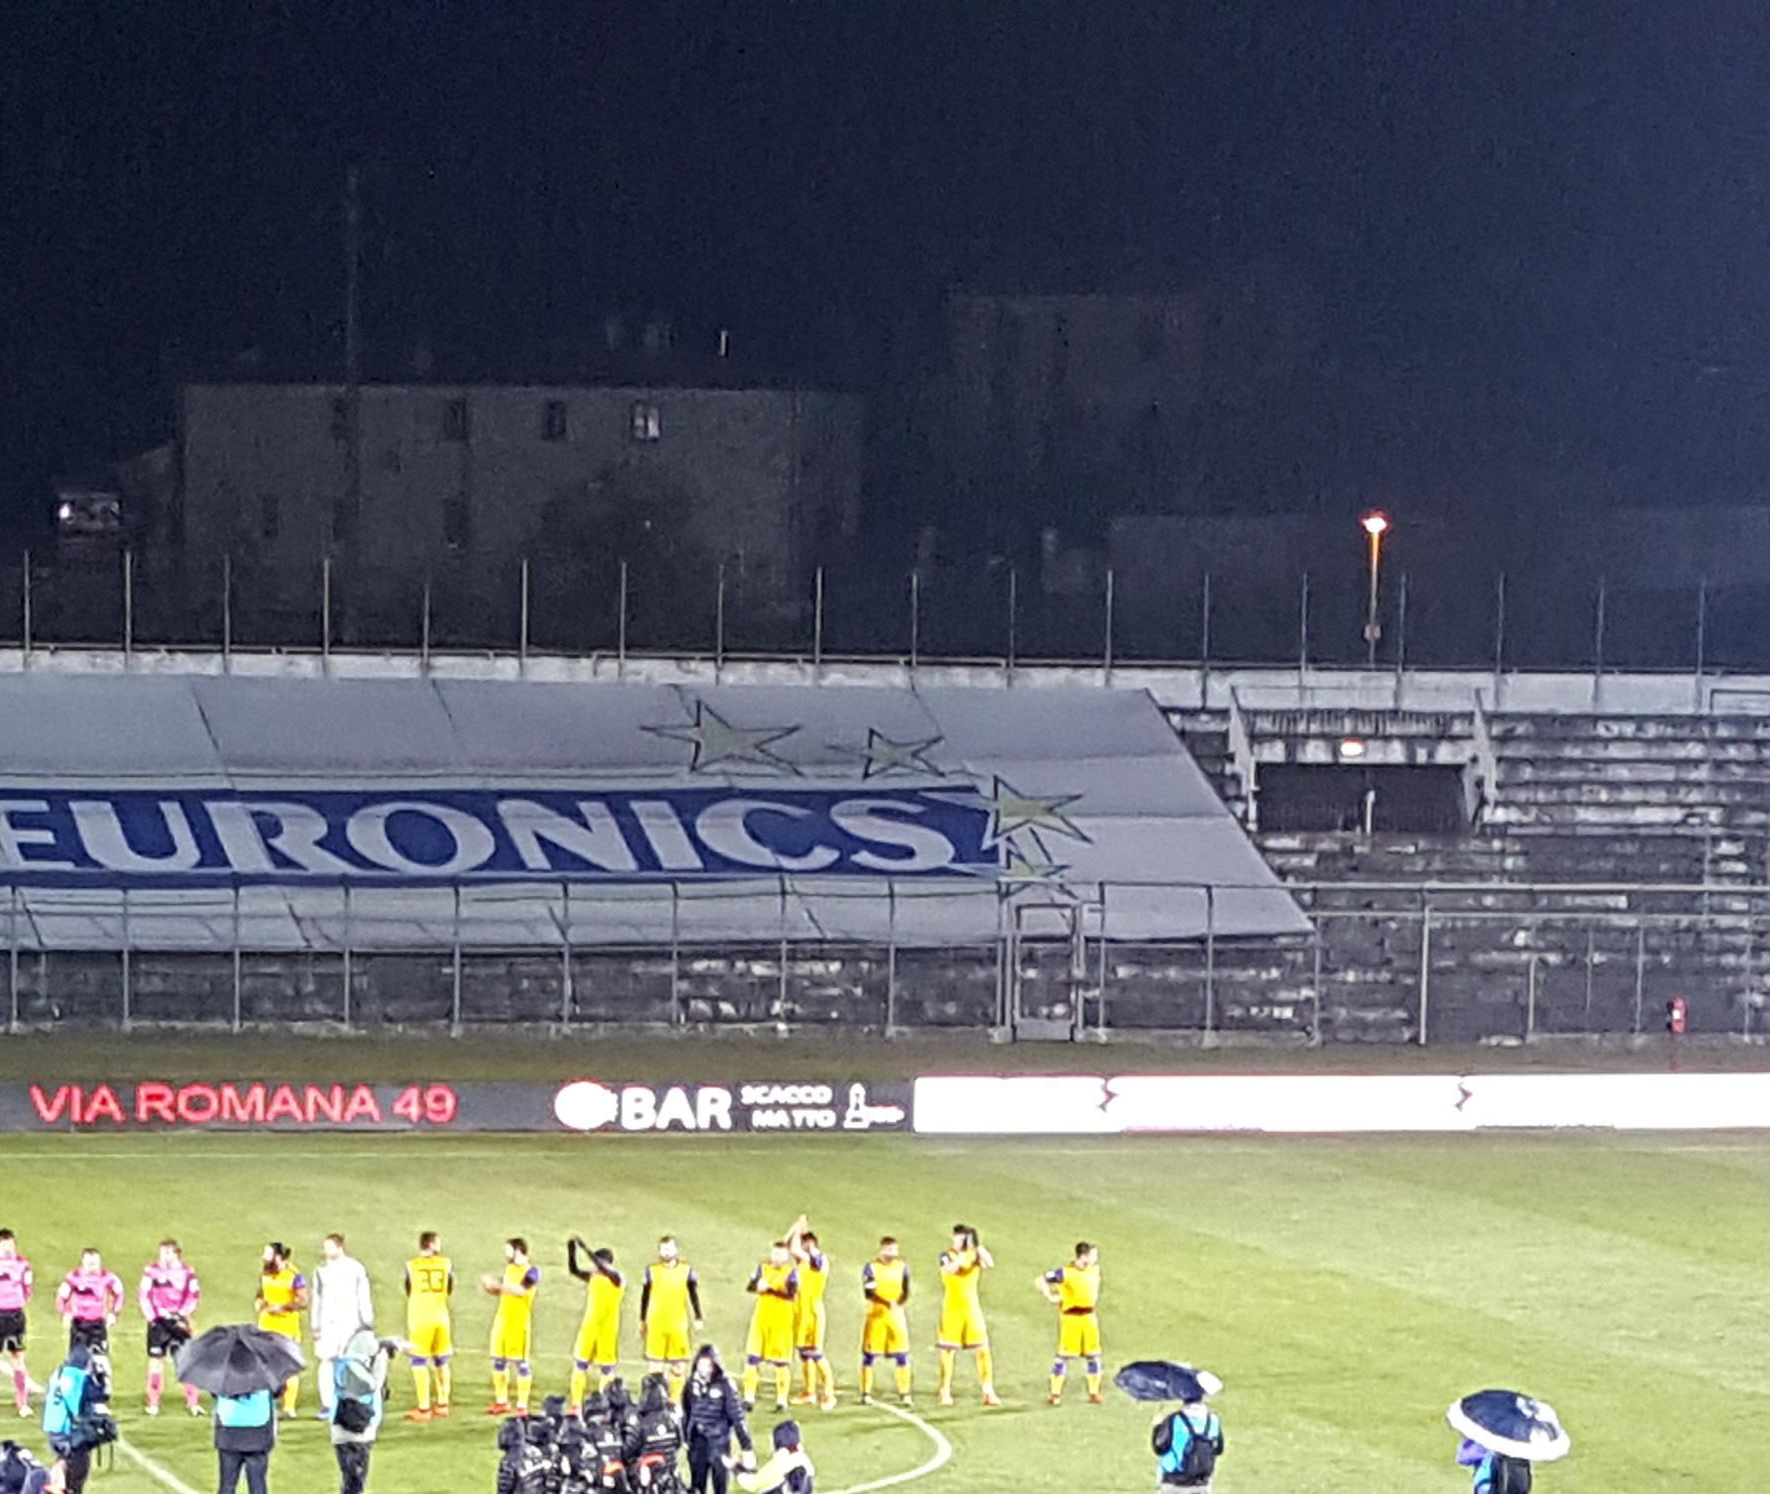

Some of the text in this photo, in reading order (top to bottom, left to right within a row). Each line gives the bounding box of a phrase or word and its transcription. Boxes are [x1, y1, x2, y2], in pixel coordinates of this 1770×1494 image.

[31, 1083, 457, 1124] VIA ROMANA 49
[620, 1086, 732, 1130] BAR
